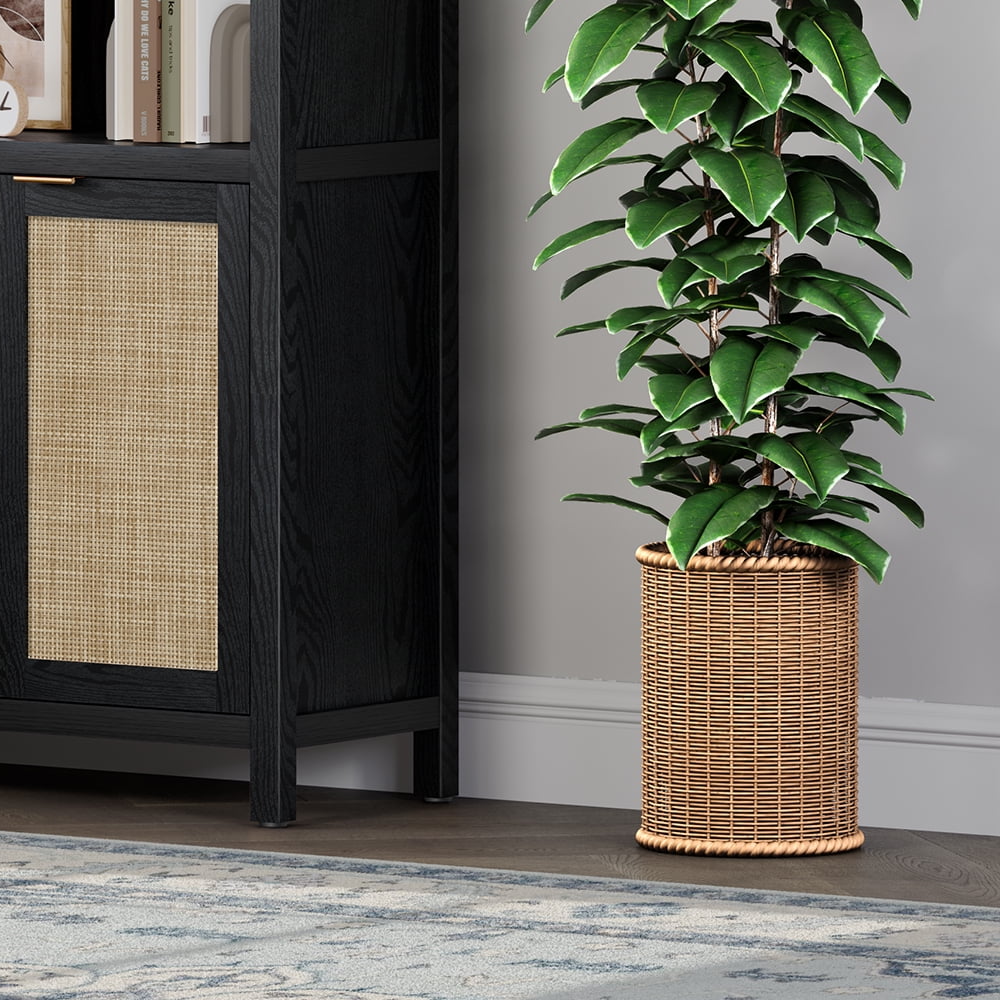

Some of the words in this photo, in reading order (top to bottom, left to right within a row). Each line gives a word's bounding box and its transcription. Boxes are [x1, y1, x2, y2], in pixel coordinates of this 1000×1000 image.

[141, 10, 149, 21] DO
[141, 24, 149, 36] WE
[141, 39, 149, 59] LOVE
[141, 61, 149, 81] CATS
